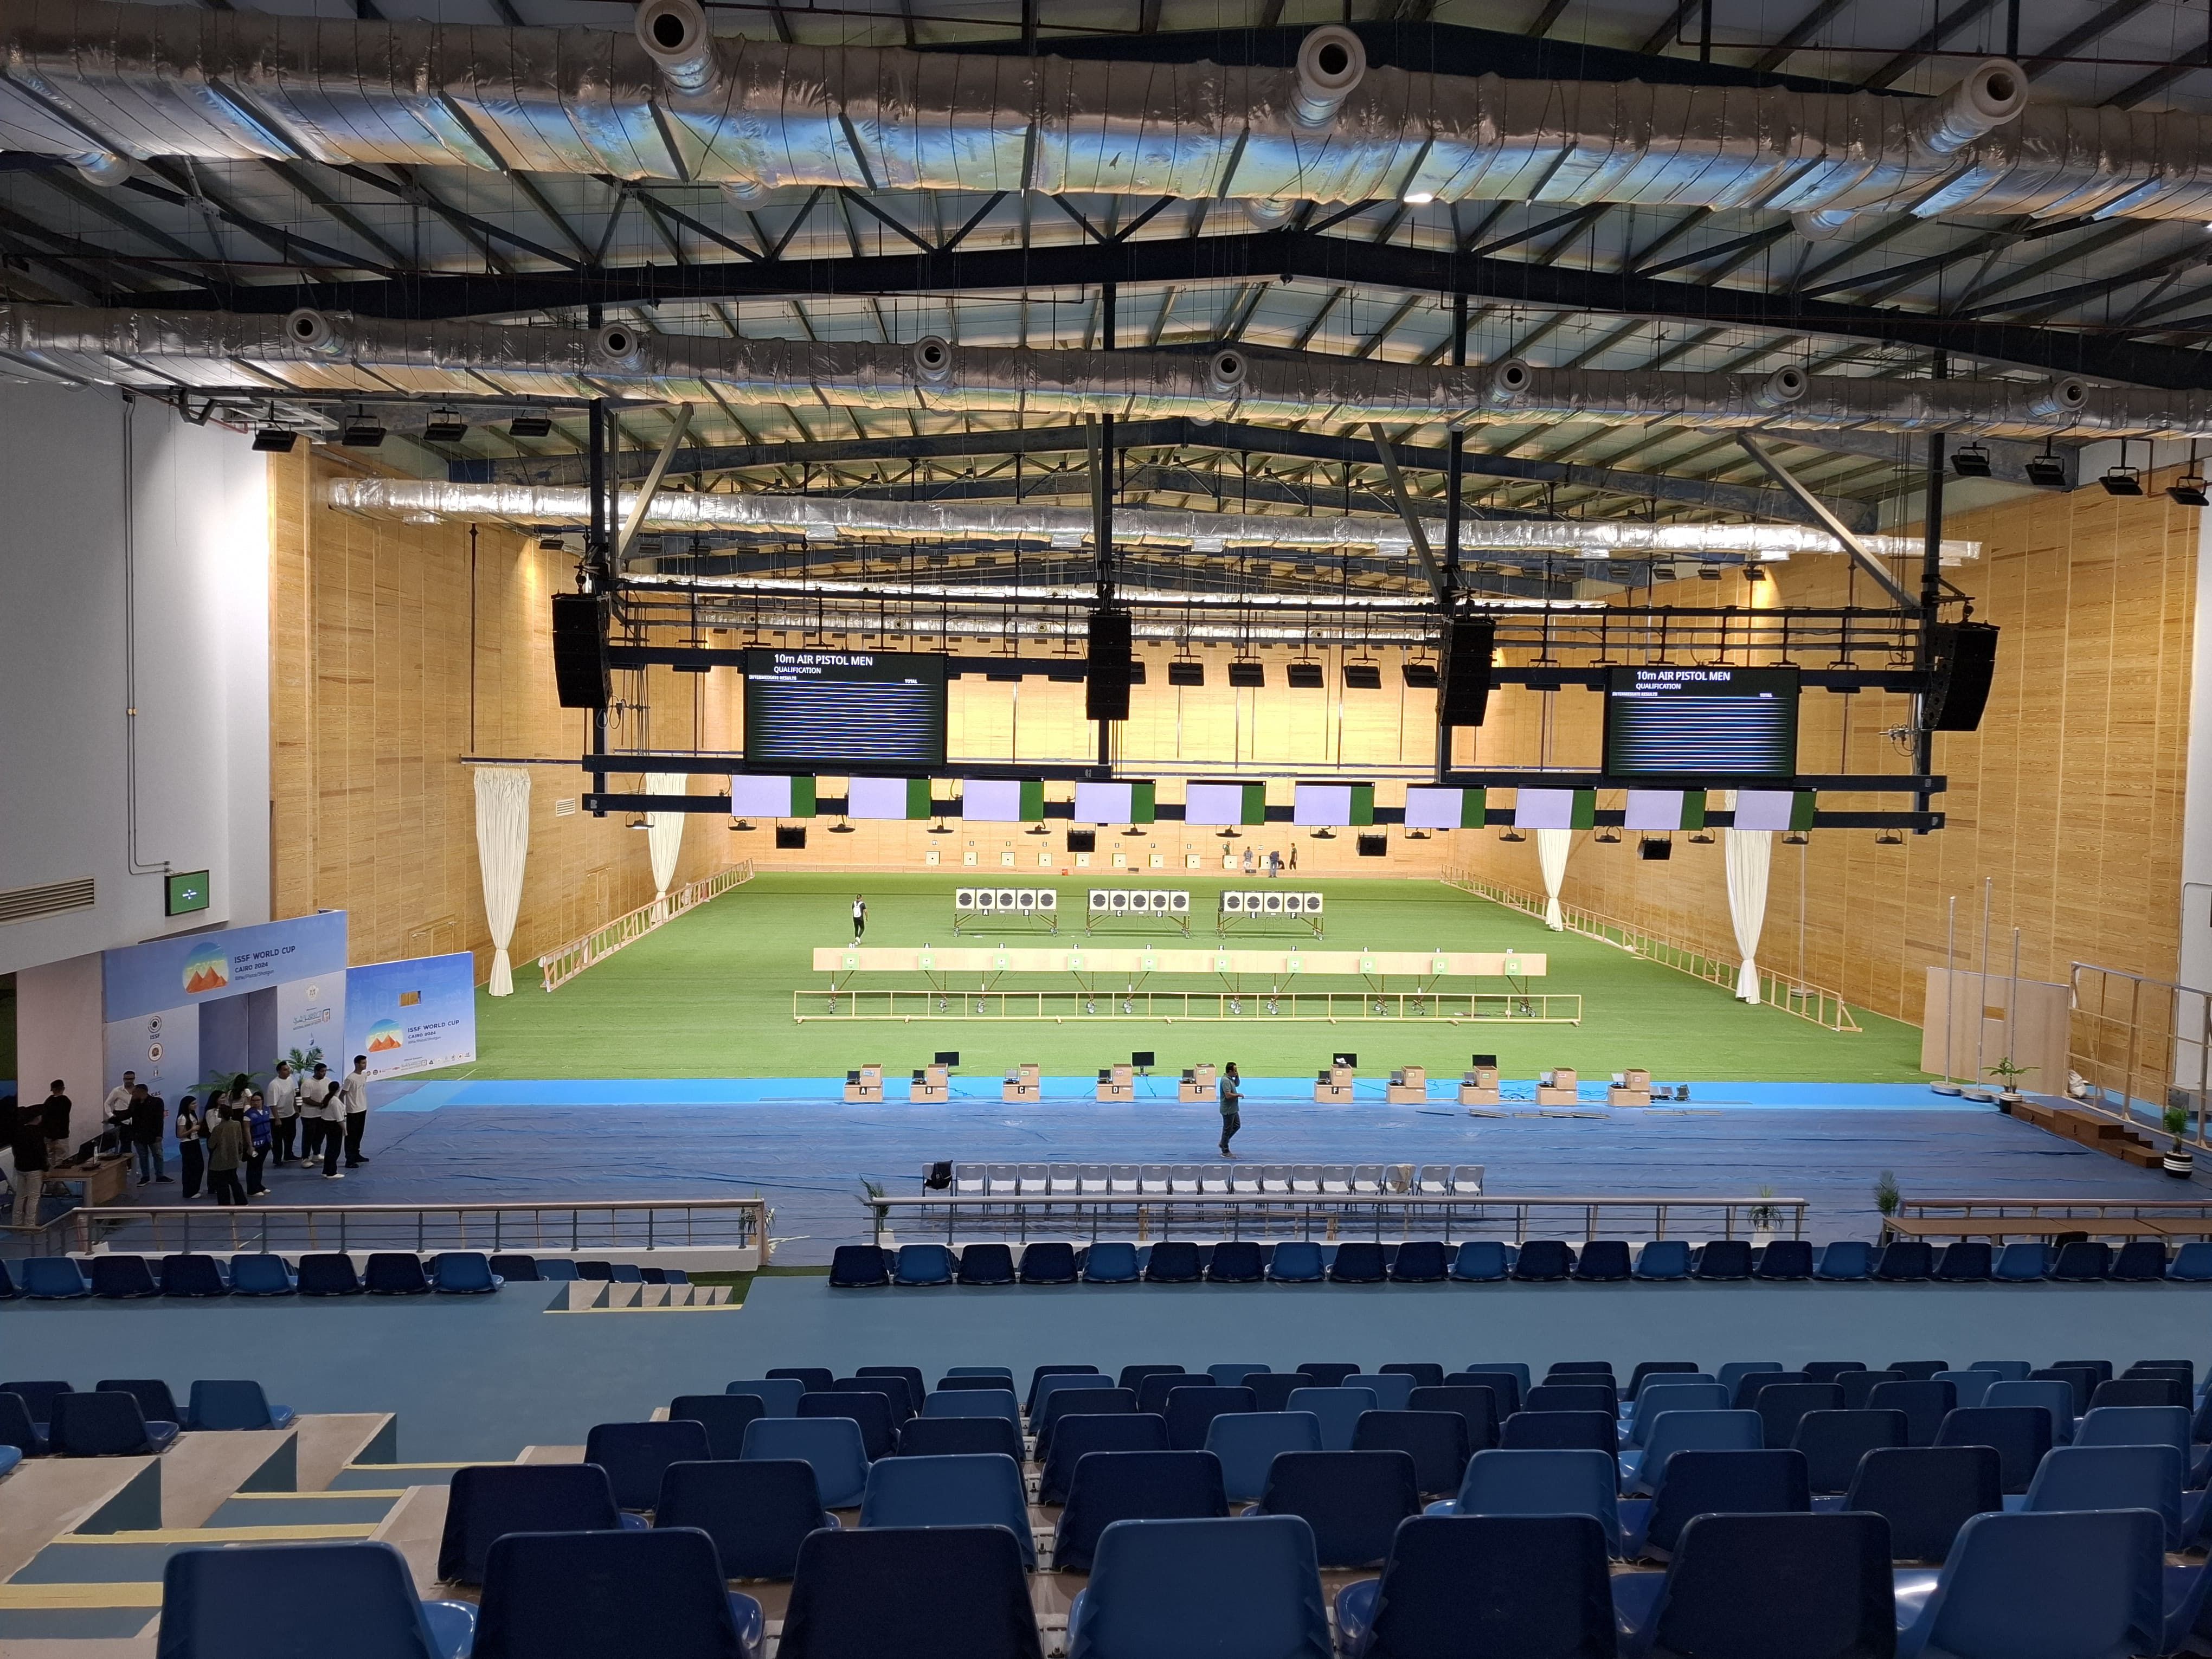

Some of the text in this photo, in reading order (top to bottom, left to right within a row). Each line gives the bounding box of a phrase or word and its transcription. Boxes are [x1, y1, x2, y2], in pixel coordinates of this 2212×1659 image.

[774, 654, 873, 666] 10m AIR PISTOL MEN
[1637, 671, 1731, 680] 10m AIR PISTOL MEN
[234, 946, 295, 963] ISSF WORLD CUP
[235, 965, 253, 973] CAIRO
